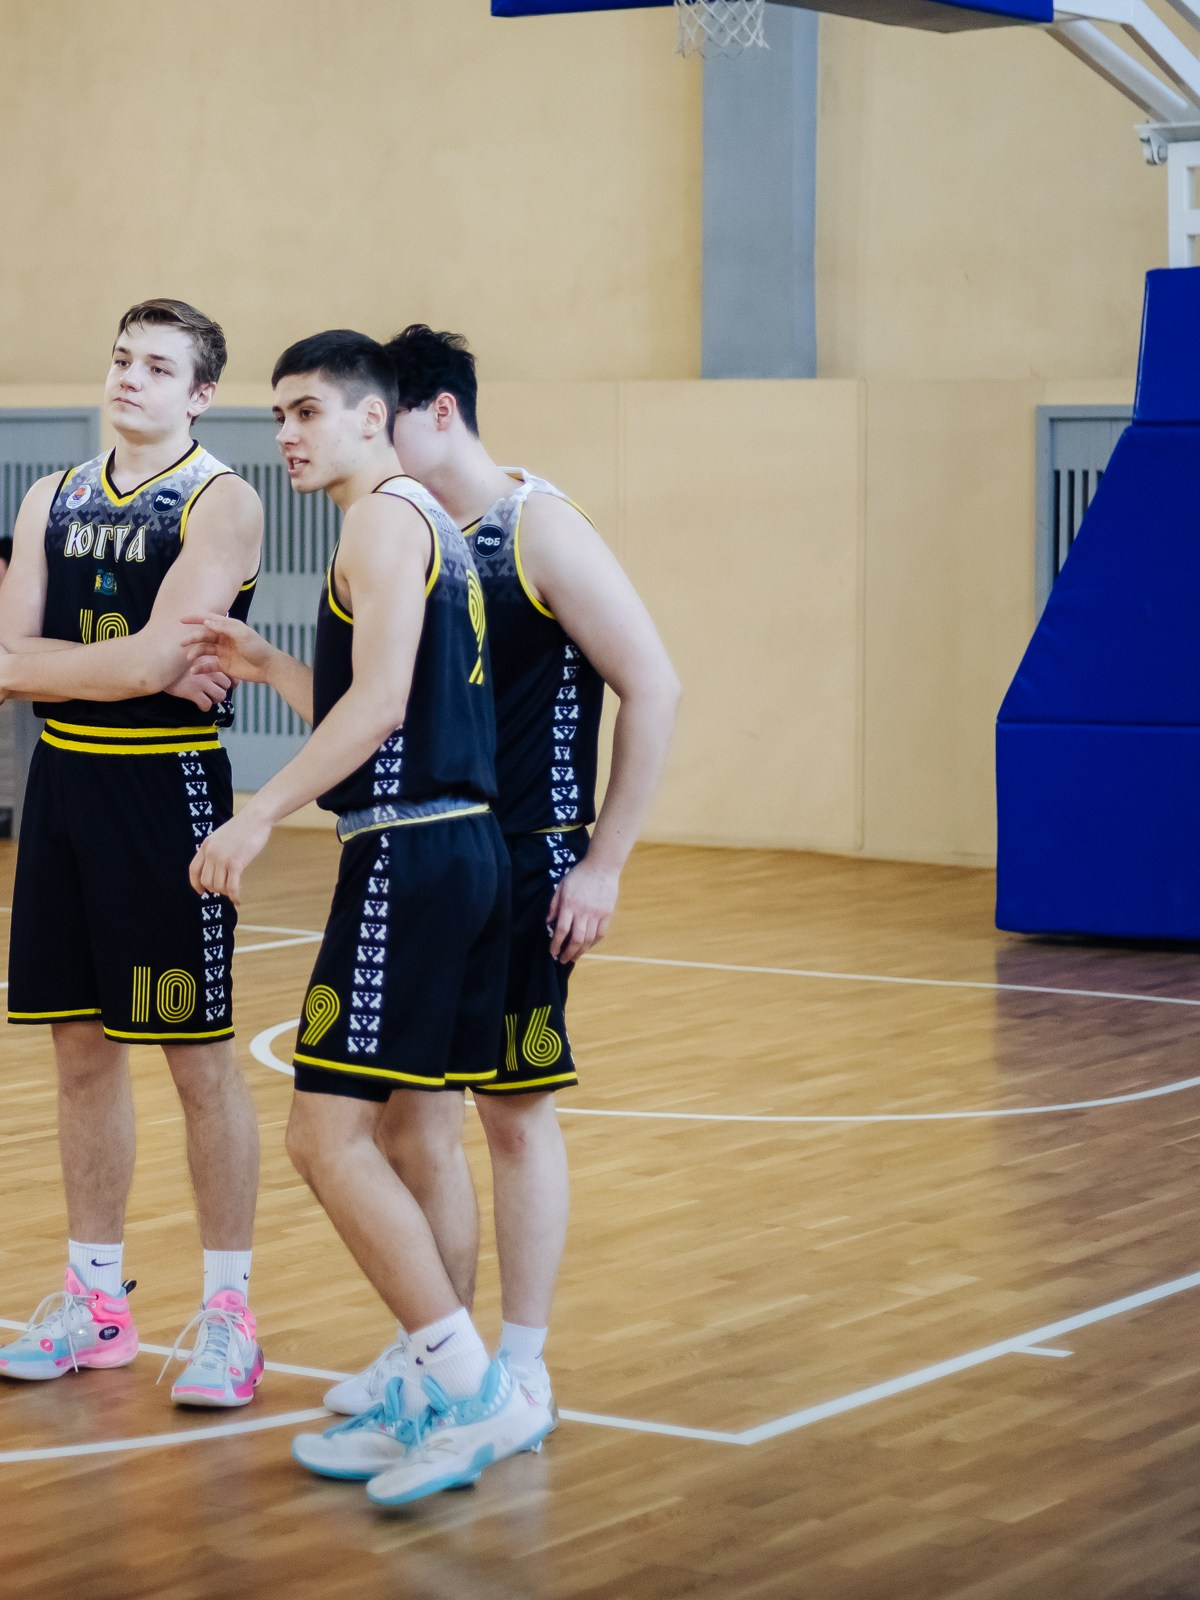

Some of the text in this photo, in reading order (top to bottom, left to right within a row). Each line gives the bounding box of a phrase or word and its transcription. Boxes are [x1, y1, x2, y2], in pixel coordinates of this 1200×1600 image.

[131, 965, 197, 1023] 10
[300, 983, 341, 1047] 9
[505, 1004, 562, 1071] 16
